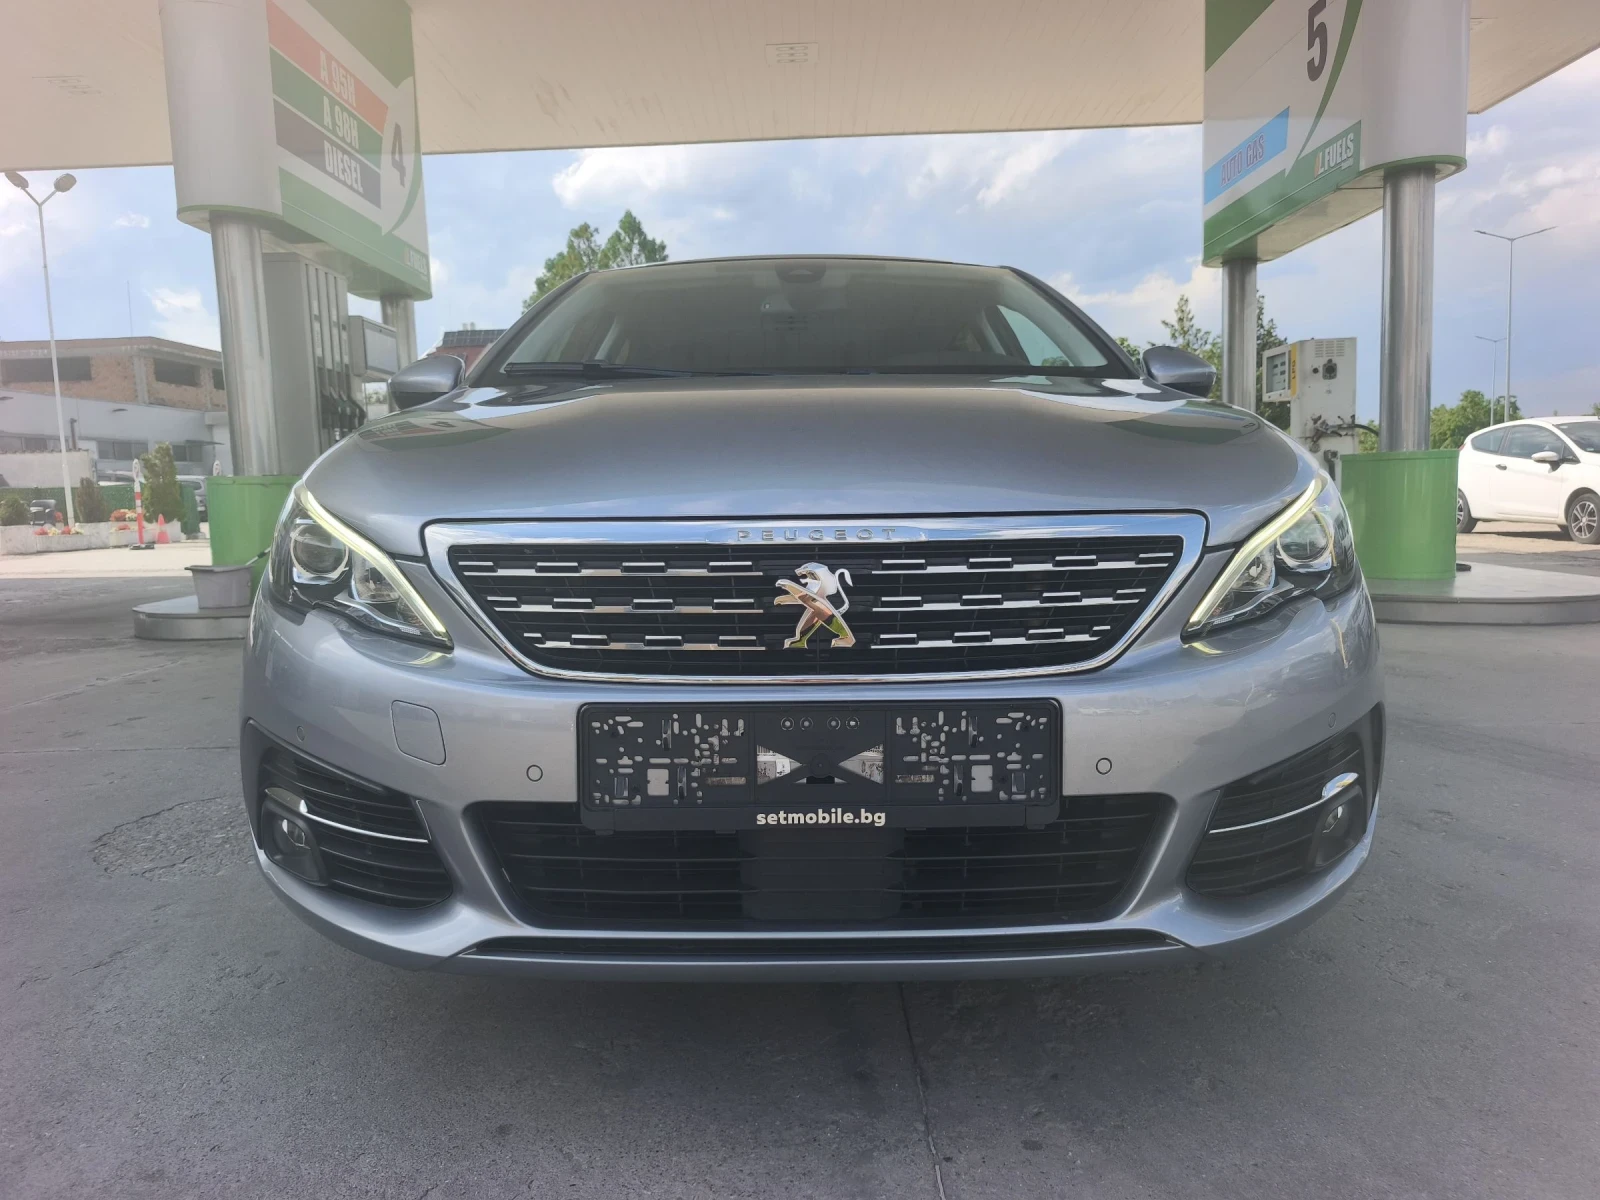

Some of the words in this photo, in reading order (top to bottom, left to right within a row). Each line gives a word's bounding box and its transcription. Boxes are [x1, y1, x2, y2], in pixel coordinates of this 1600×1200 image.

[1307, 0, 1328, 82] 5
[320, 50, 329, 85] A
[323, 96, 333, 130] A
[323, 139, 364, 194] DIESEL
[391, 122, 406, 188] 4
[1220, 150, 1242, 187] AUTO
[1246, 134, 1264, 168] GAS
[736, 528, 896, 542] PEUGEOT
[756, 808, 886, 827] setmobile.bg
